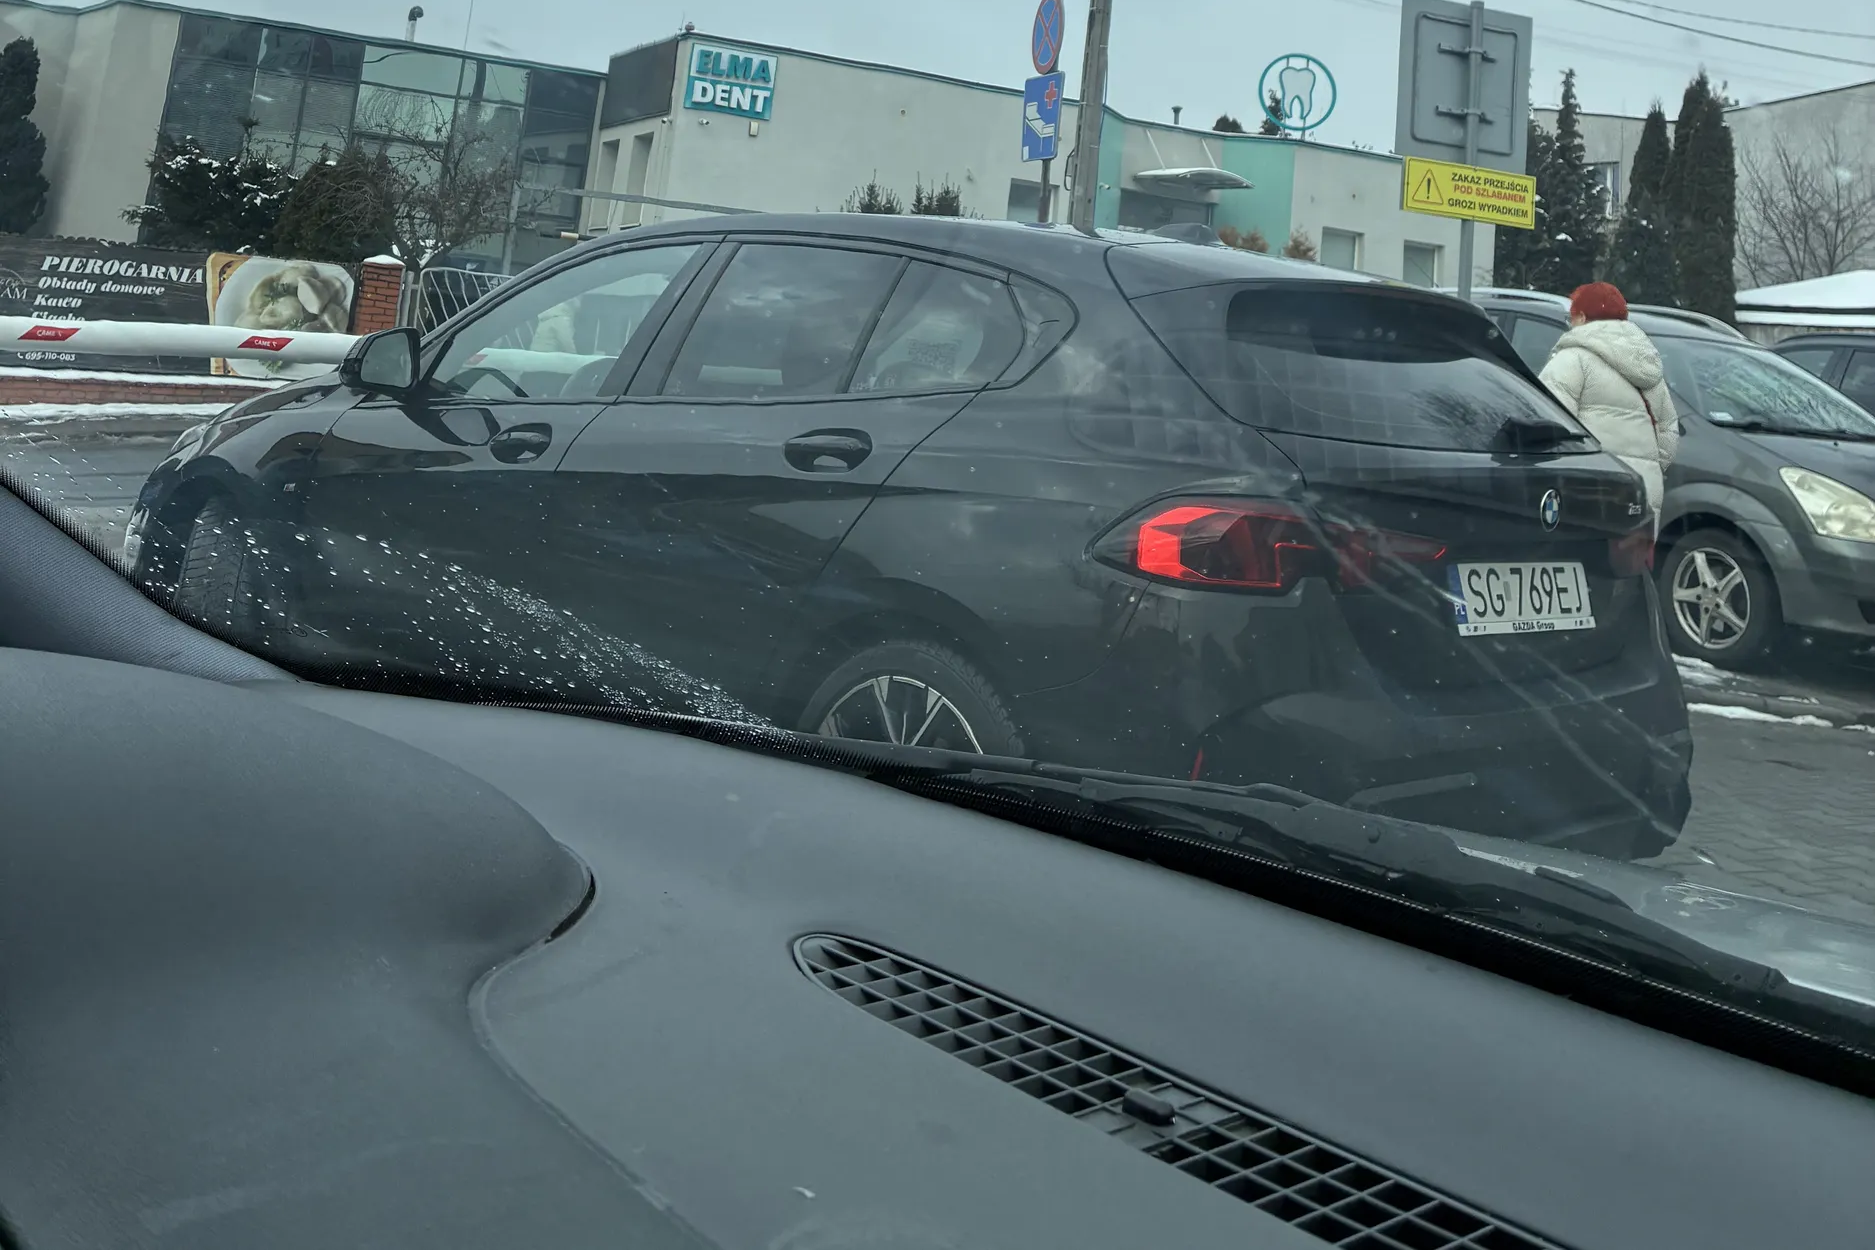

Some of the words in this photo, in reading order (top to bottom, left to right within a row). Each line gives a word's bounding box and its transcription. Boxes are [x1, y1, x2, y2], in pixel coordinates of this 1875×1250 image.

[696, 49, 771, 83] ELMA
[692, 80, 770, 112] DENT
[1452, 172, 1481, 186] ZAKAZ
[1484, 177, 1529, 193] PRZEJŚCIA
[1454, 184, 1473, 195] POD
[1475, 187, 1526, 203] SZLABANEM
[1448, 198, 1476, 210] GROZI
[1478, 202, 1528, 218] WYPADKIEM
[40, 255, 204, 284] PIEROGARNIA
[38, 276, 97, 294] Obiady
[100, 280, 165, 296] domowe
[254, 339, 271, 347] CAME
[1467, 567, 1506, 618] SG
[1509, 566, 1582, 617] 769EJ
[1454, 603, 1466, 616] PL
[1537, 620, 1555, 631] Group
